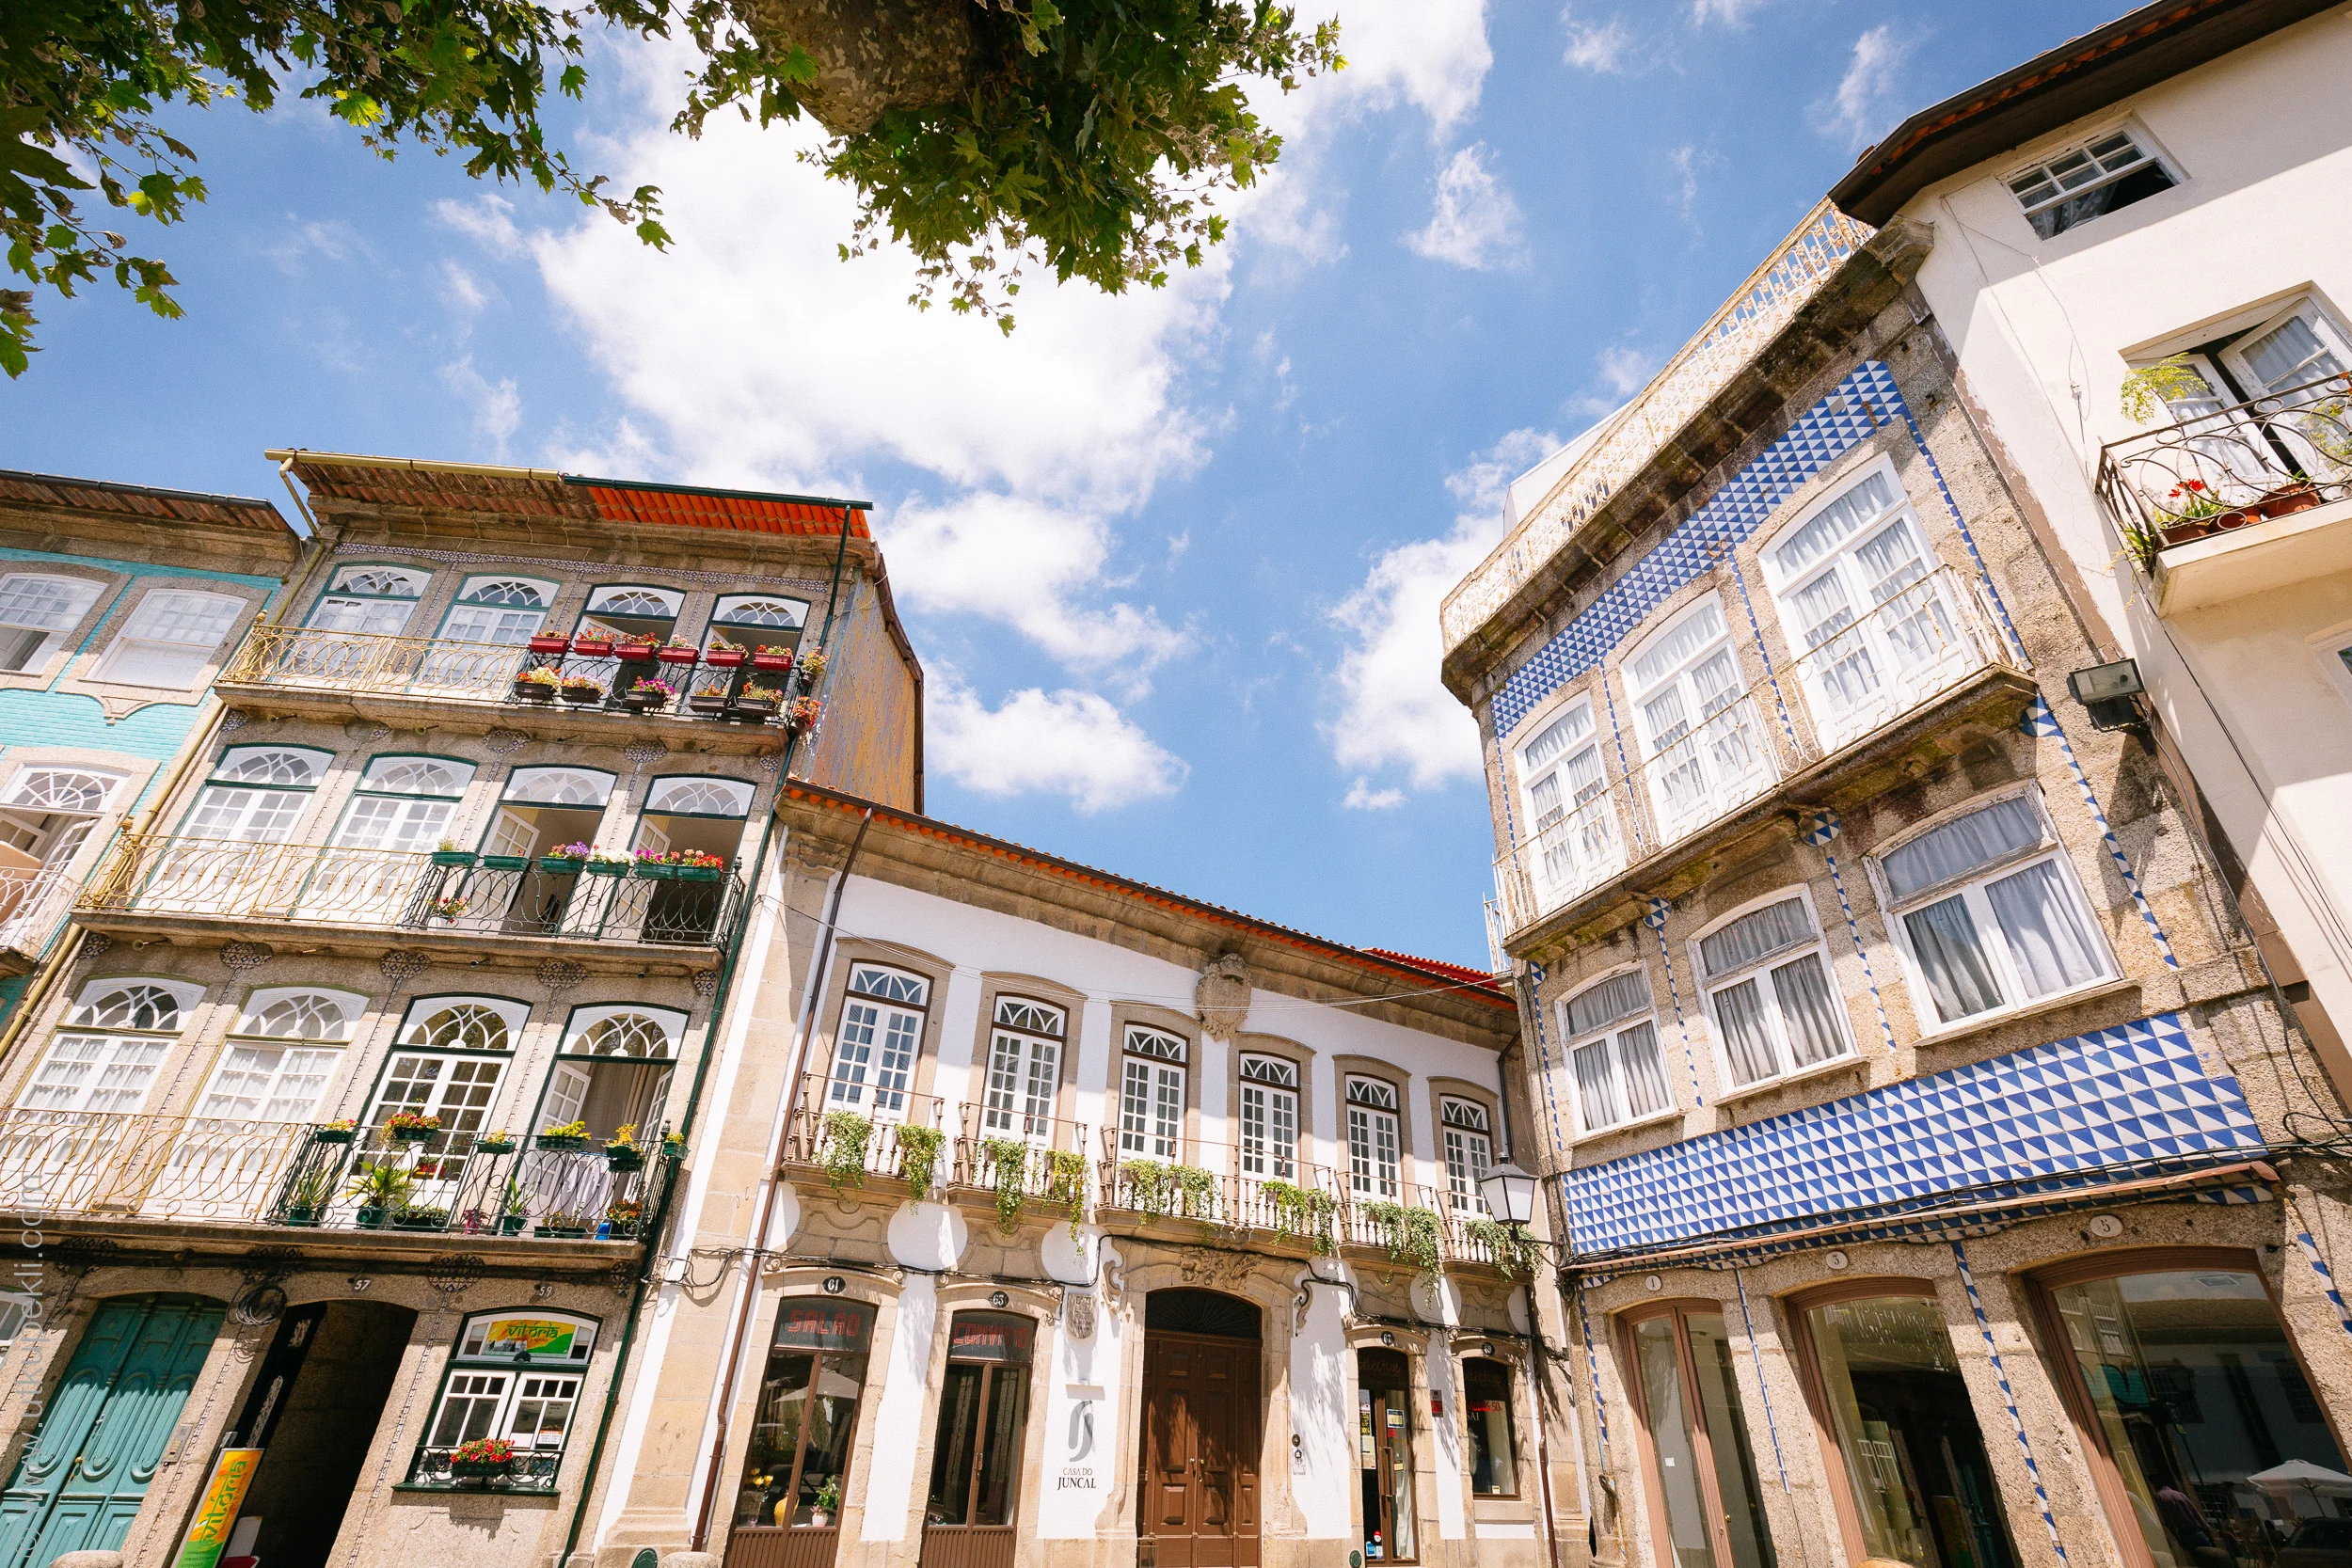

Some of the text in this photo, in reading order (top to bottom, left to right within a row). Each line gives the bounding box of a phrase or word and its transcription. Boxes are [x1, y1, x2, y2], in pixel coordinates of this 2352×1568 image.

[2100, 1219, 2110, 1232] 5
[1833, 1255, 1840, 1265] 3
[354, 1279, 371, 1290] 57
[827, 1278, 839, 1291] 61
[539, 1286, 552, 1297] 59
[993, 1294, 1004, 1306] 63
[787, 1307, 861, 1337] SALÃO
[953, 1321, 1031, 1349] CONVÍVIO
[1383, 1334, 1392, 1343] 67
[1484, 1345, 1492, 1354] 69
[1063, 1467, 1092, 1476] CASA DO
[1057, 1477, 1097, 1491] JUNCAL
